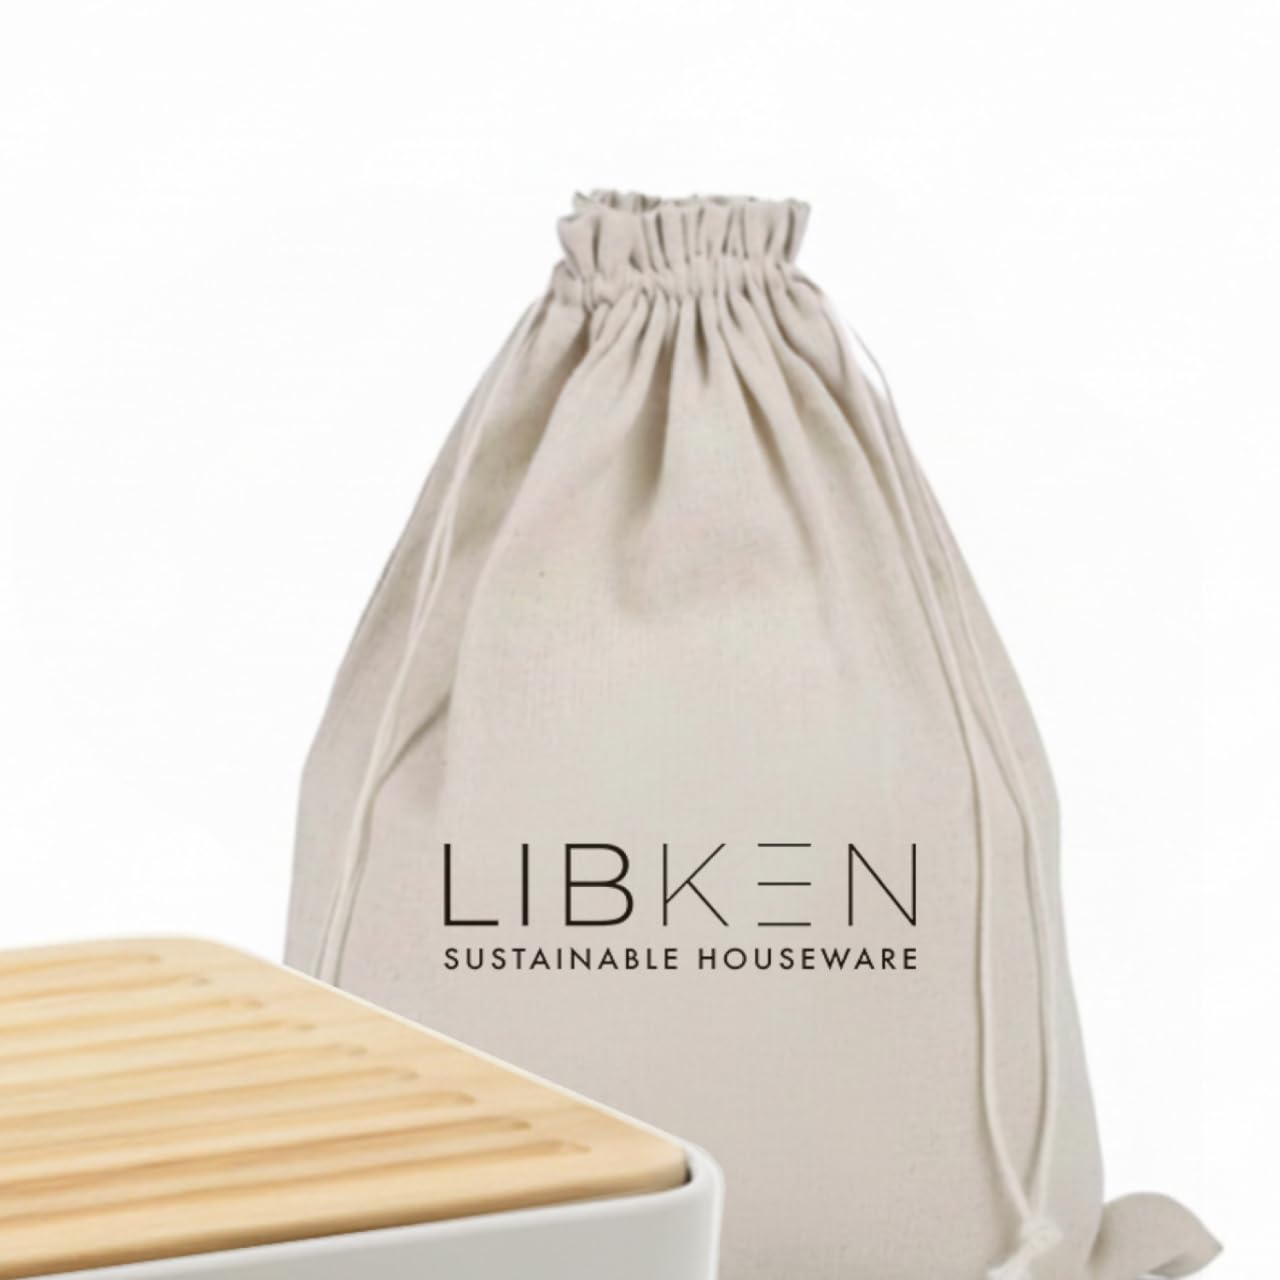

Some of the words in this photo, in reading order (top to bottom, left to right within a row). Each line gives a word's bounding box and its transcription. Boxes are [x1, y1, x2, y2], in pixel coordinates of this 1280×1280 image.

[443, 843, 918, 927] LIBKEN
[444, 947, 679, 970] SUSTAINABLE
[698, 947, 918, 970] HOUSEWARE
